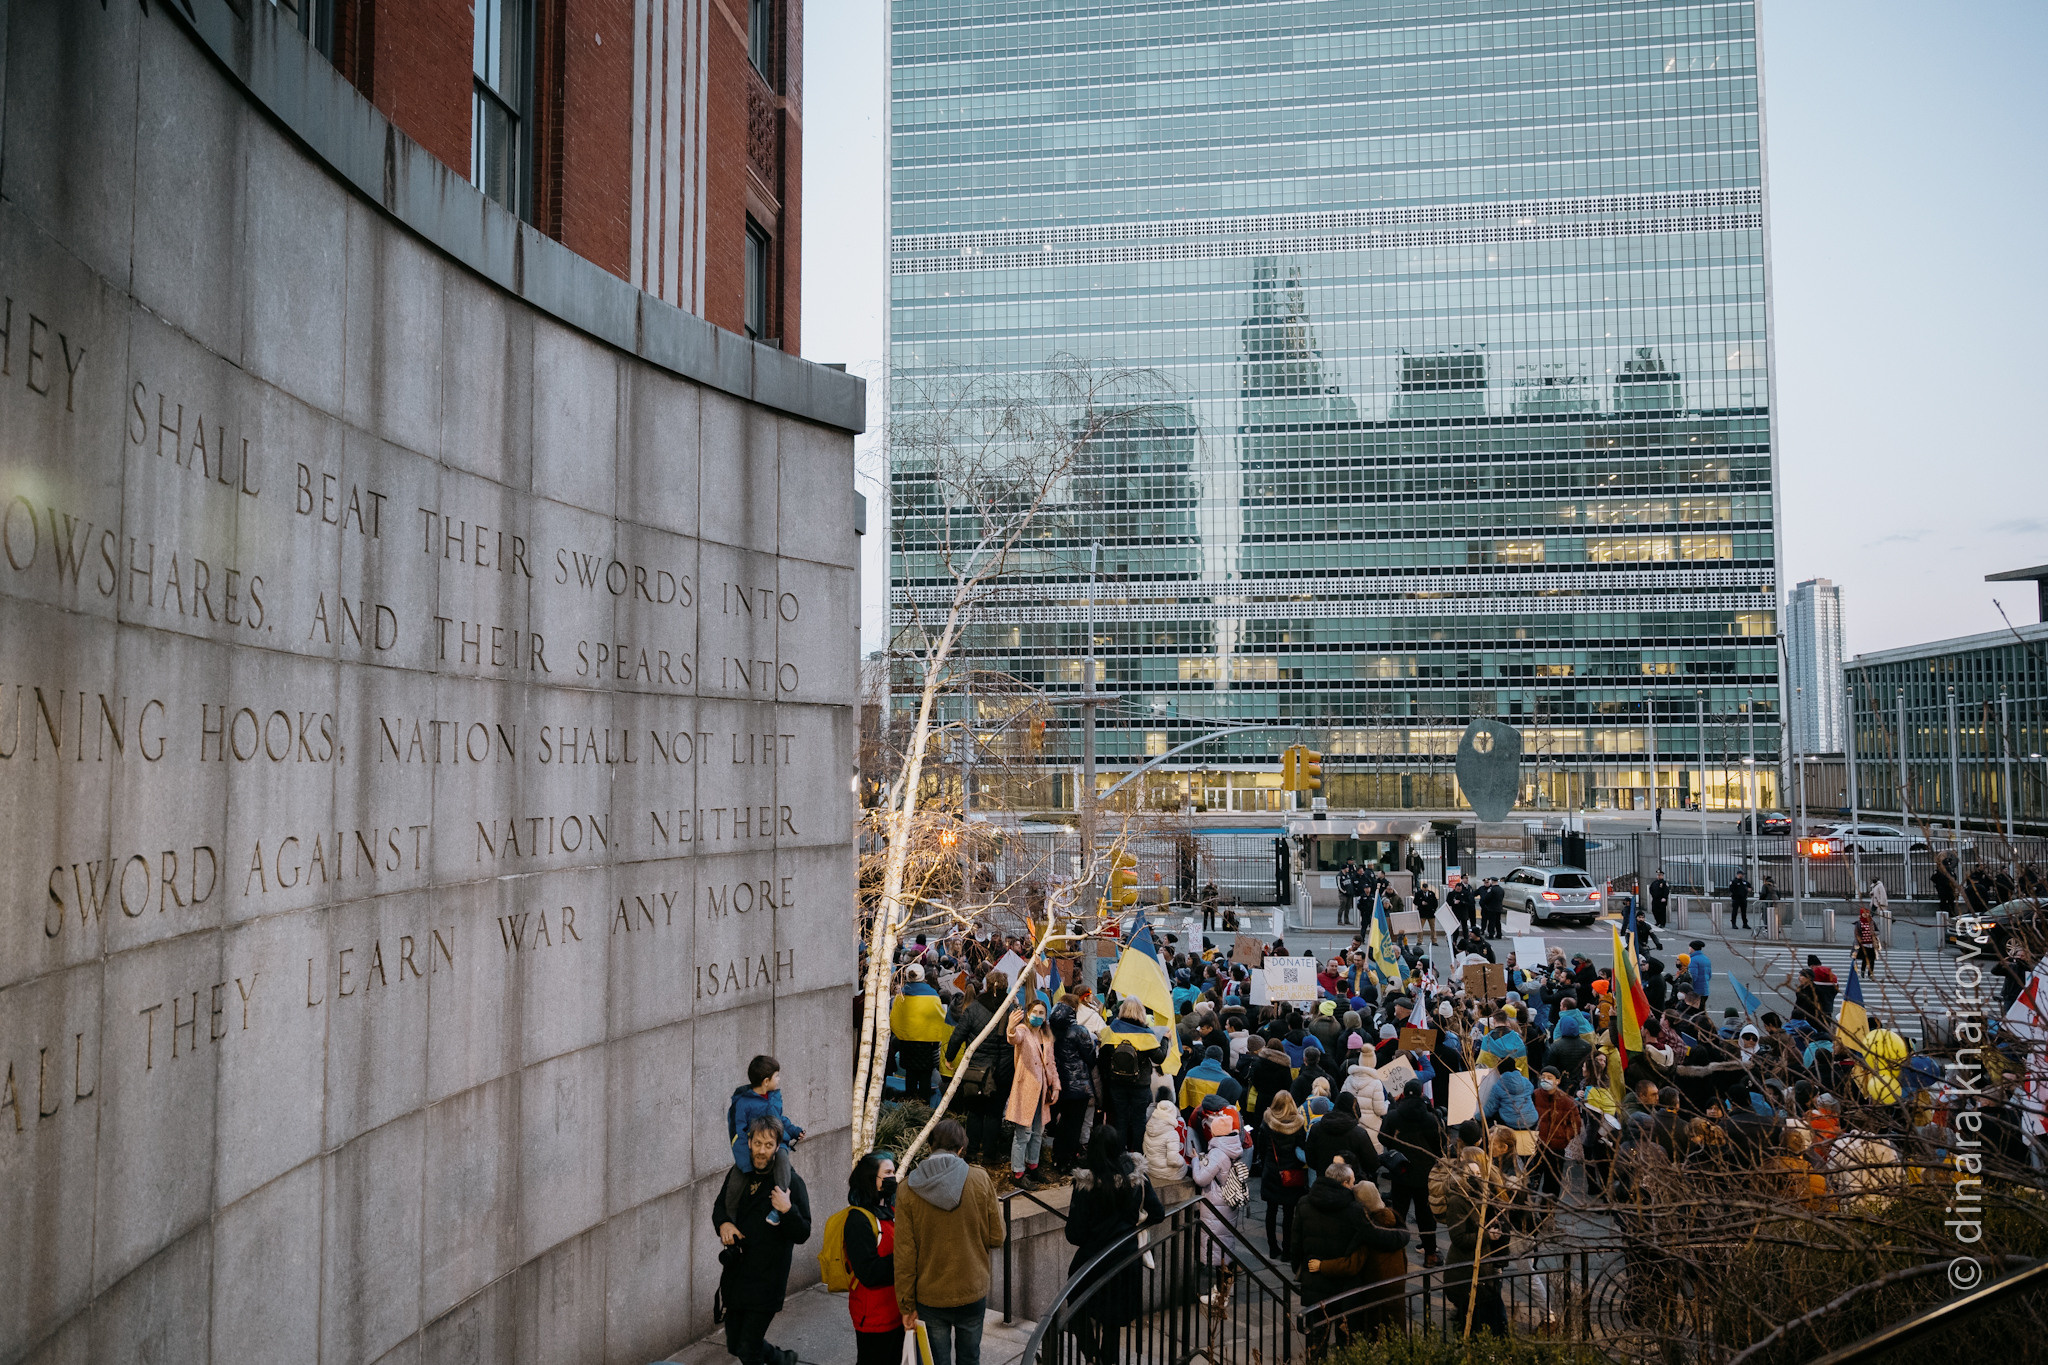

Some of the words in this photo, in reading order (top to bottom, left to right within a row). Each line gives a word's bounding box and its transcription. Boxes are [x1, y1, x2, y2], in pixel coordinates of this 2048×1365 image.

[129, 381, 261, 498] SHALL
[295, 462, 388, 539] BEAT
[418, 507, 534, 579] THEIR
[555, 548, 693, 608] SWORDS
[722, 582, 800, 623] INTO
[3, 495, 273, 633] OWSHARES.
[308, 590, 399, 652] AND
[433, 615, 552, 674] THEIR
[576, 640, 693, 686] SPEARS
[721, 656, 800, 694] INTO
[200, 703, 346, 765] HOOKS;
[379, 717, 518, 765] NATION
[538, 725, 638, 765] SHALL
[650, 730, 714, 765] NOT
[731, 733, 796, 765] LIFT
[44, 845, 218, 940] SWORD
[244, 825, 429, 896] AGAINST
[475, 813, 620, 862] NATION.
[650, 804, 799, 846] NEITHER
[139, 973, 259, 1072] THEY
[306, 925, 456, 1009] LEARN
[498, 905, 583, 958] WAR
[612, 890, 679, 936] ANY
[708, 876, 796, 920] MORE
[696, 947, 796, 1001] ISAIAH
[1271, 957, 1314, 968] DONATE!
